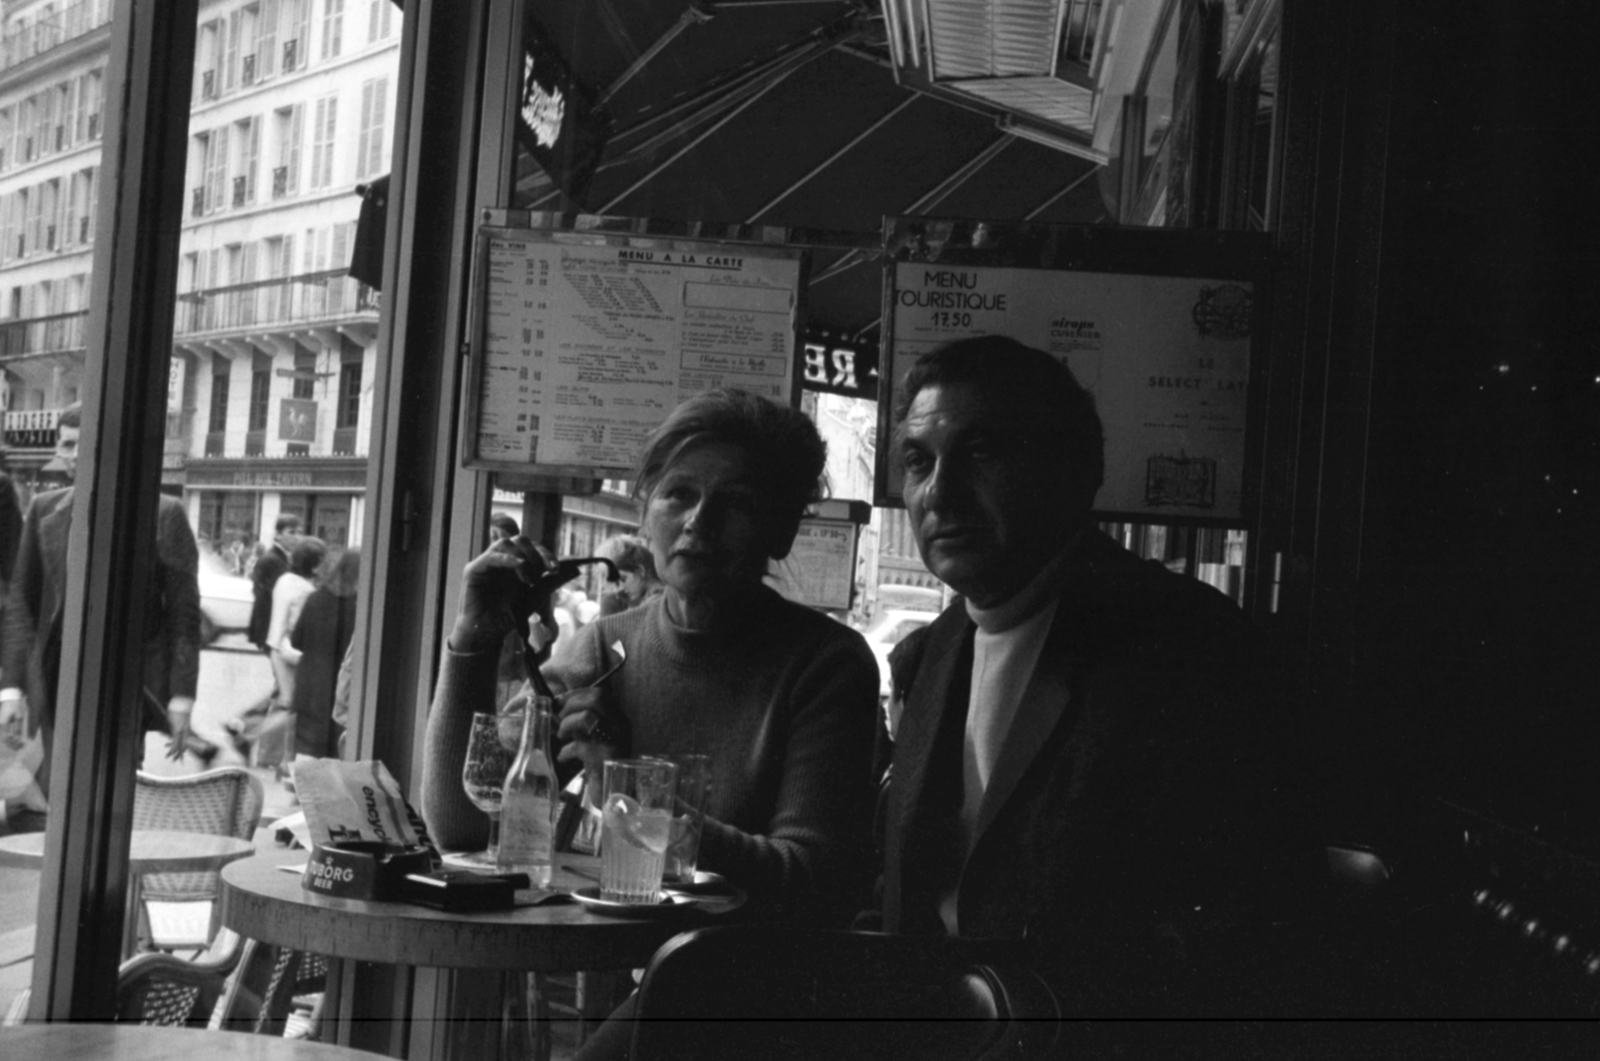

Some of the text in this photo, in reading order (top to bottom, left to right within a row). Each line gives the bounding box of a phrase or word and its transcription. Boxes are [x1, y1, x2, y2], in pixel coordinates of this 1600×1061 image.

[618, 249, 743, 267] MENU A LA CARTE
[925, 270, 977, 290] MENU
[894, 289, 1007, 312] TOURISTIQUE
[1050, 331, 1101, 341] CUSENIER
[1051, 317, 1096, 337] sirops
[1199, 357, 1215, 370] LE
[1148, 376, 1202, 389] SELECT
